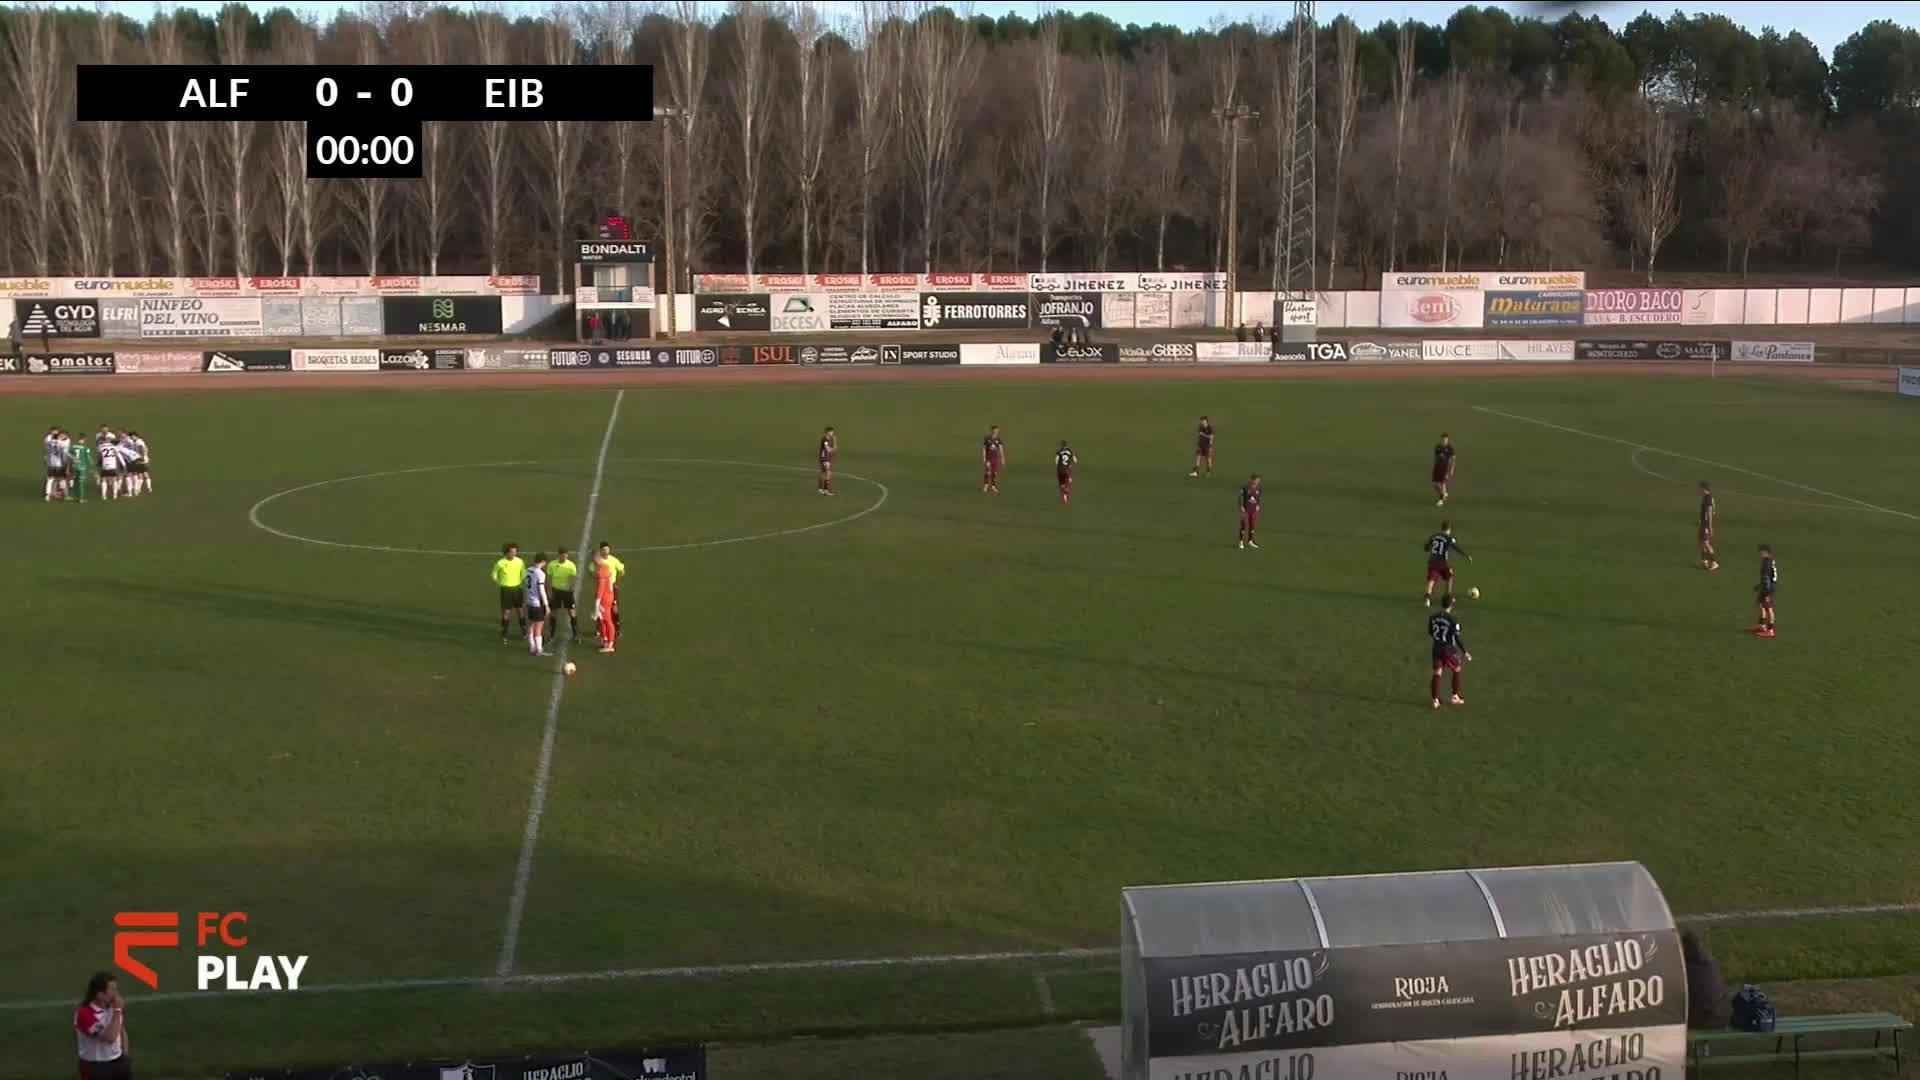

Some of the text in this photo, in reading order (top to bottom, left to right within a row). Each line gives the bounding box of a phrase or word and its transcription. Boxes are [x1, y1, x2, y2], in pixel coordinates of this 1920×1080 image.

[581, 245, 646, 254] BONDALTI
[0, 279, 48, 290] ueble
[74, 279, 174, 290] euromueble
[880, 275, 915, 284] EROSKI
[935, 275, 969, 284] EROSKI
[1064, 280, 1125, 290] JIMENEZ
[1397, 275, 1480, 285] euromueble
[1499, 275, 1579, 285] euromueble
[142, 299, 202, 311] NINFEO
[1586, 291, 1681, 311] DIORO BACO
[55, 305, 95, 320] GYD
[945, 305, 1026, 319] FERROTORRES
[1039, 302, 1094, 314] JOFRANJO
[143, 313, 219, 325] DEL VINO
[773, 316, 826, 330] DECESA
[419, 323, 467, 332] NESMAR
[1307, 344, 1347, 359] TGA
[50, 356, 112, 366] amatec
[103, 448, 115, 458] 23
[1432, 541, 1444, 555] 21
[1433, 624, 1448, 642] 27
[1508, 939, 1643, 996] HERACLIO
[1171, 957, 1312, 1017] HERACLIO
[1395, 976, 1449, 999] RIOJA
[1554, 976, 1664, 1029] ALFARO
[1219, 994, 1334, 1049] ALFARO
